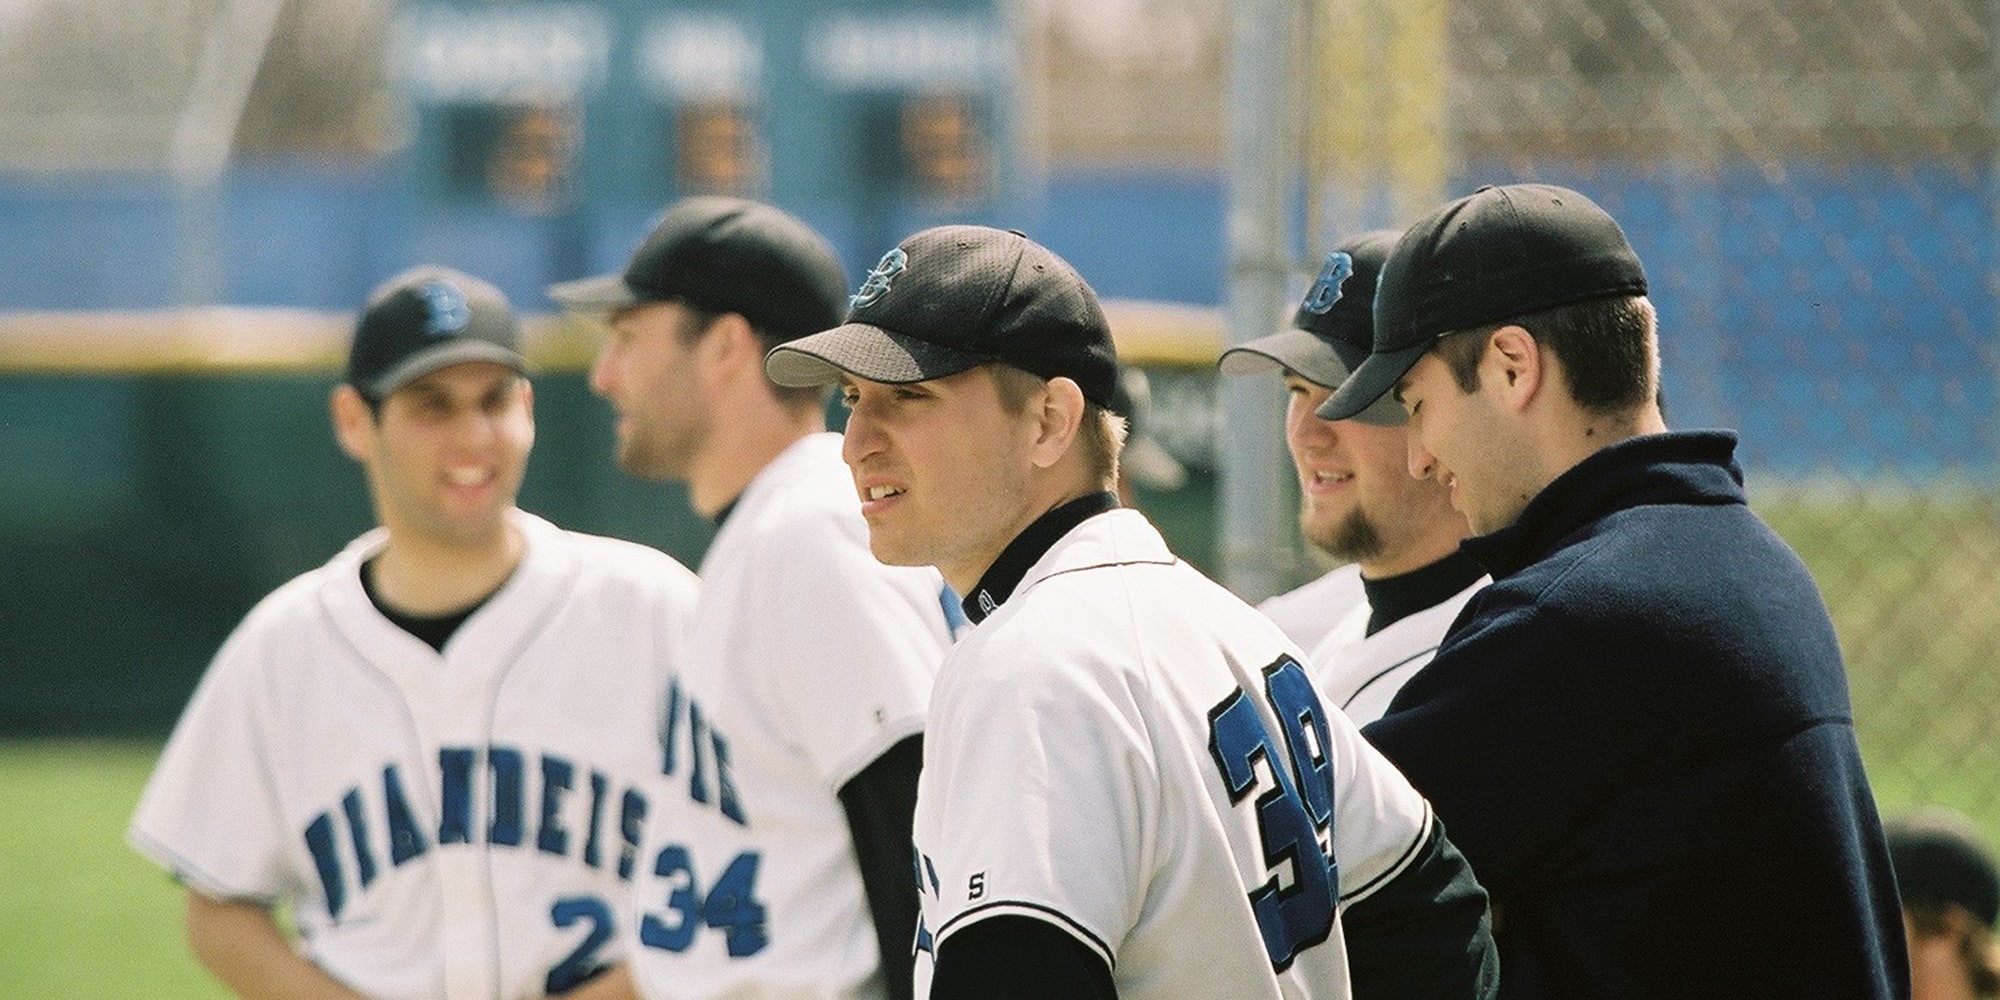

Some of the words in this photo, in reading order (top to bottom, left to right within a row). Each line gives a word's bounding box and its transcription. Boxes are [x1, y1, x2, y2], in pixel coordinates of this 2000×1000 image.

[849, 247, 907, 309] B
[1303, 251, 1353, 315] B
[1207, 652, 1340, 975] 39
[640, 844, 769, 957] 34
[968, 872, 985, 900] S
